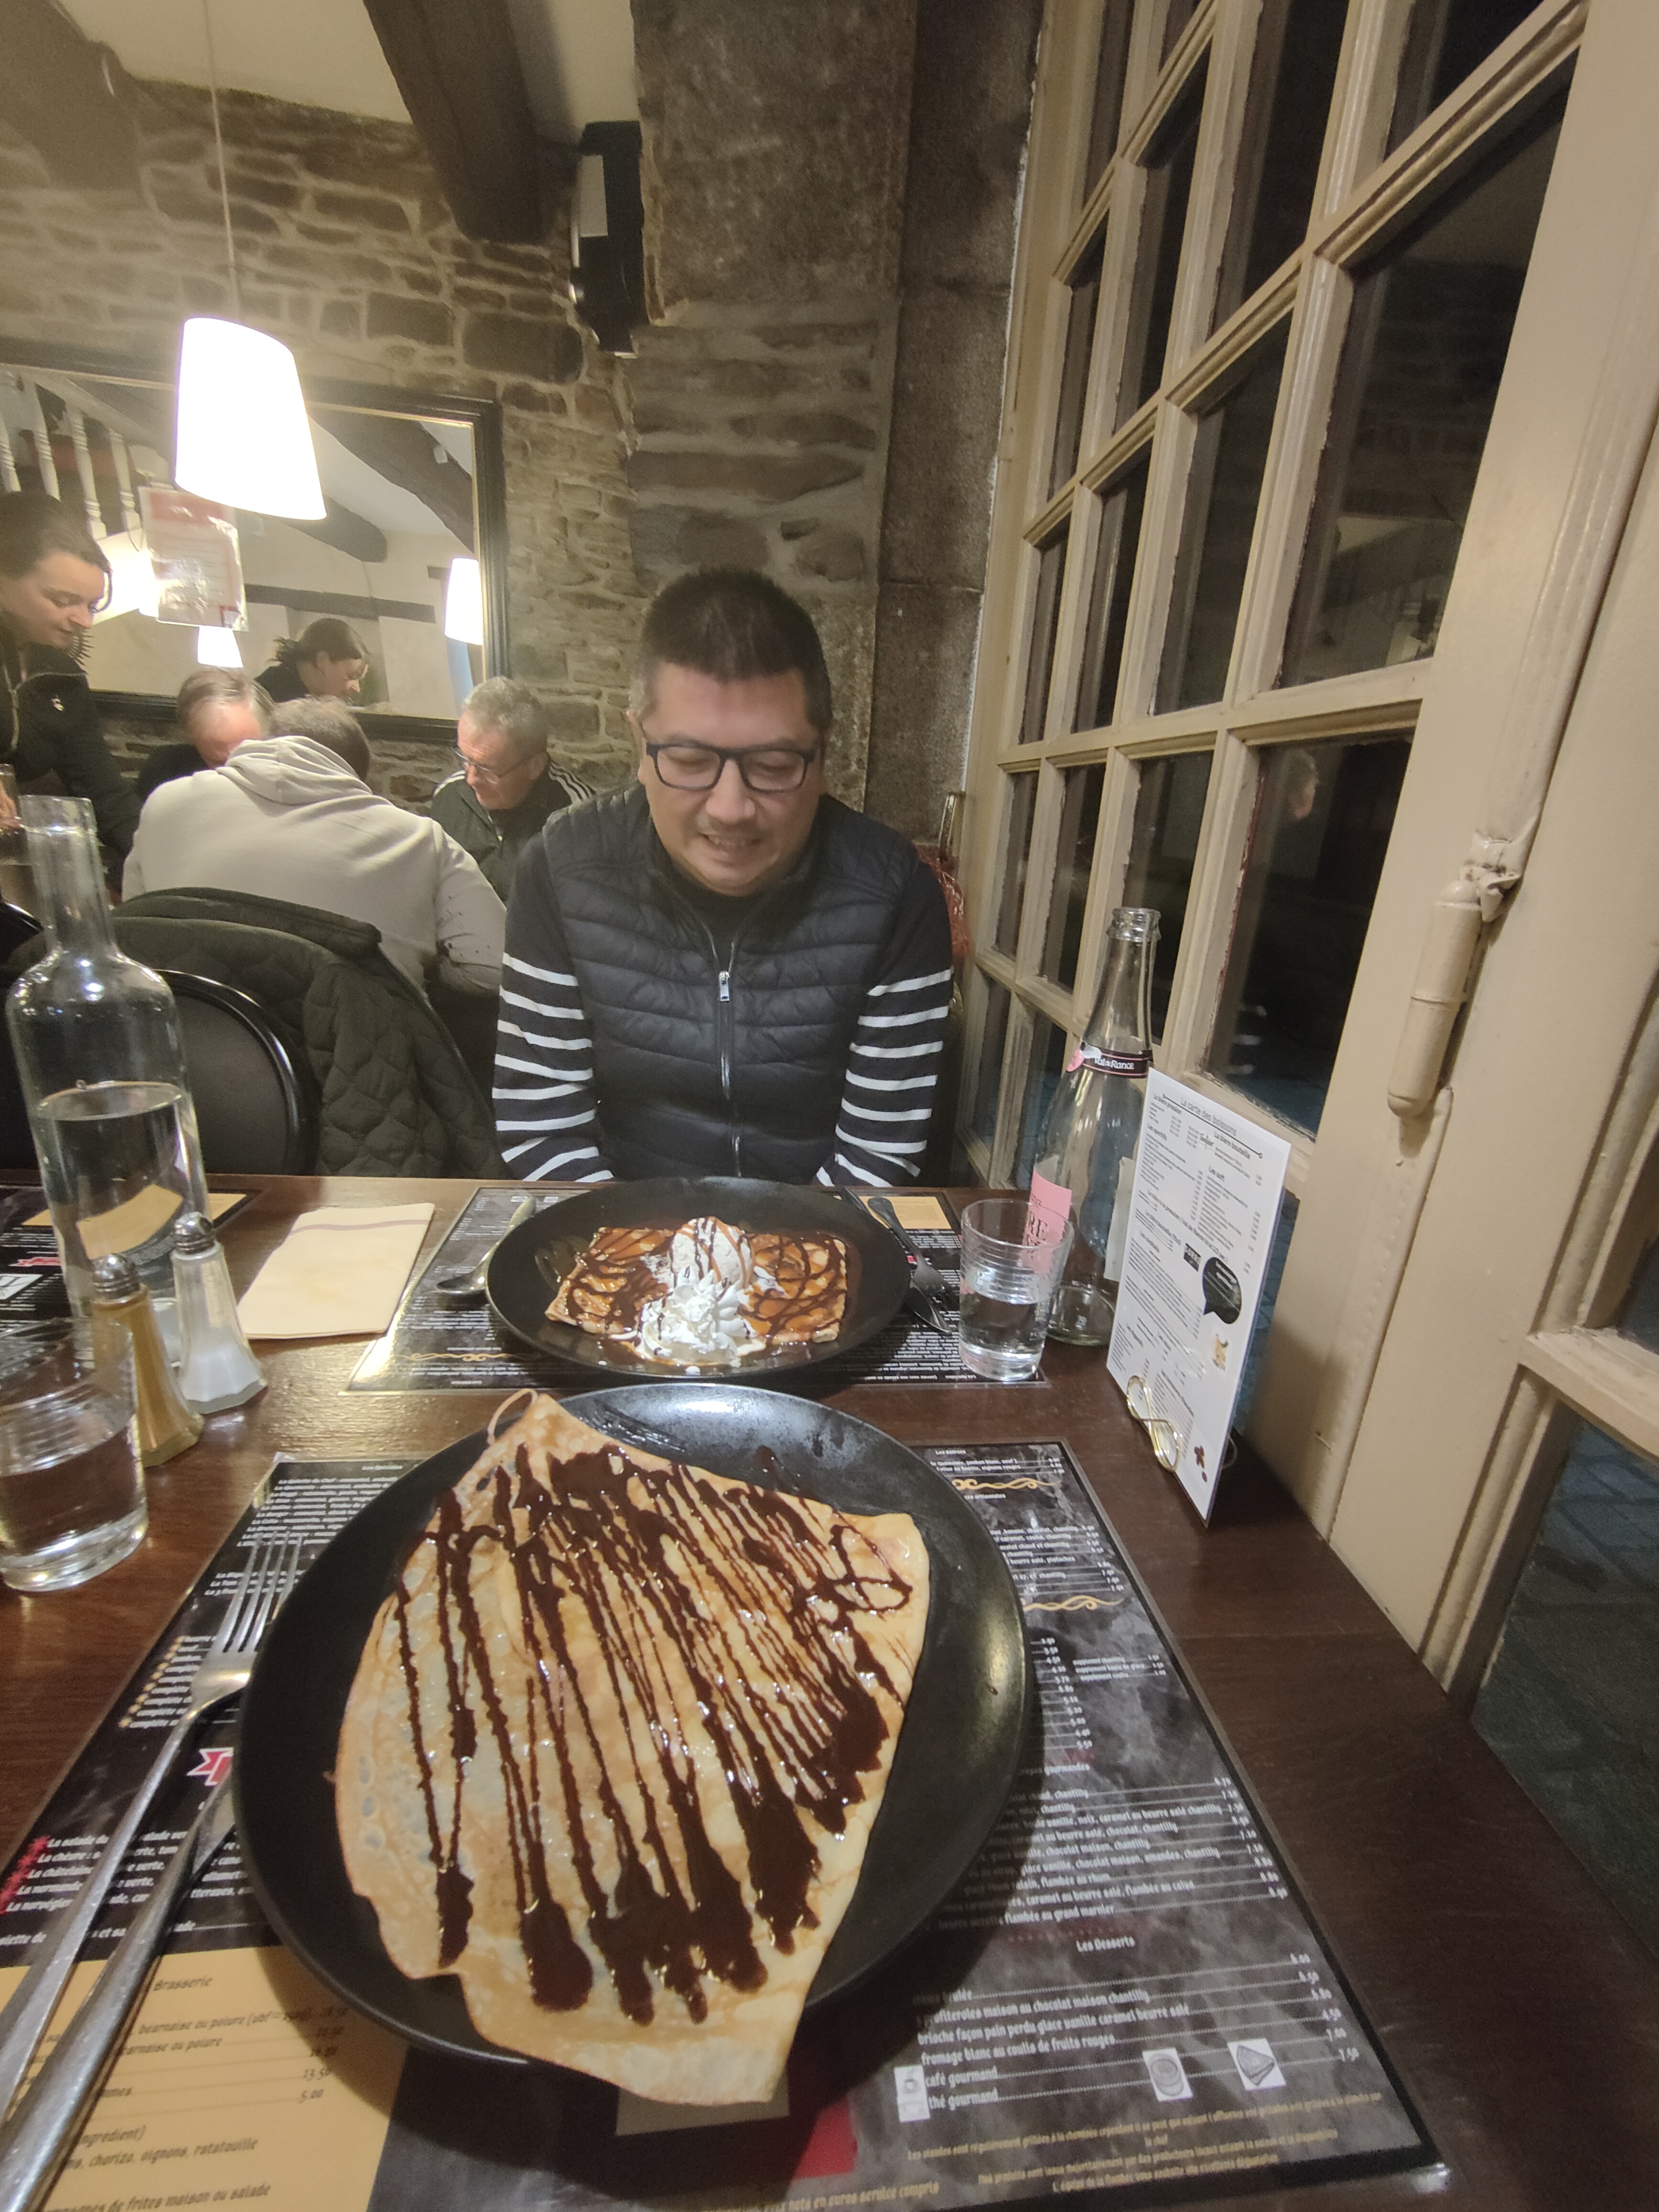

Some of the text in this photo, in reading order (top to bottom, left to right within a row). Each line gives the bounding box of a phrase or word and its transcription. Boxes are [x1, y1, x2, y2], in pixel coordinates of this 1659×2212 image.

[1187, 1102, 1201, 1116] carte
[1212, 1115, 1237, 1137] boissons
[1076, 1936, 1136, 1953] Les Desserts
[152, 1977, 212, 1991] Brasserie
[195, 2020, 208, 2030] ou
[984, 2024, 1006, 2041] pain
[1007, 2020, 1036, 2038] perdu
[921, 2051, 962, 2066] fromage
[964, 2046, 991, 2061] blanc
[993, 2046, 1005, 2057] au
[1037, 2038, 1050, 2053] de
[1051, 2035, 1081, 2051] fruits
[1081, 2033, 1116, 2049] rouges
[924, 2071, 946, 2088] café
[948, 2065, 998, 2088] gourmand
[928, 2093, 946, 2110] thé
[948, 2086, 998, 2111] gourmand
[194, 2137, 259, 2156] ratatouille
[126, 2195, 163, 2212] frites
[164, 2192, 210, 2207] maison
[212, 2189, 227, 2201] ou
[231, 2183, 271, 2200] salade
[898, 2181, 940, 2200] compris
